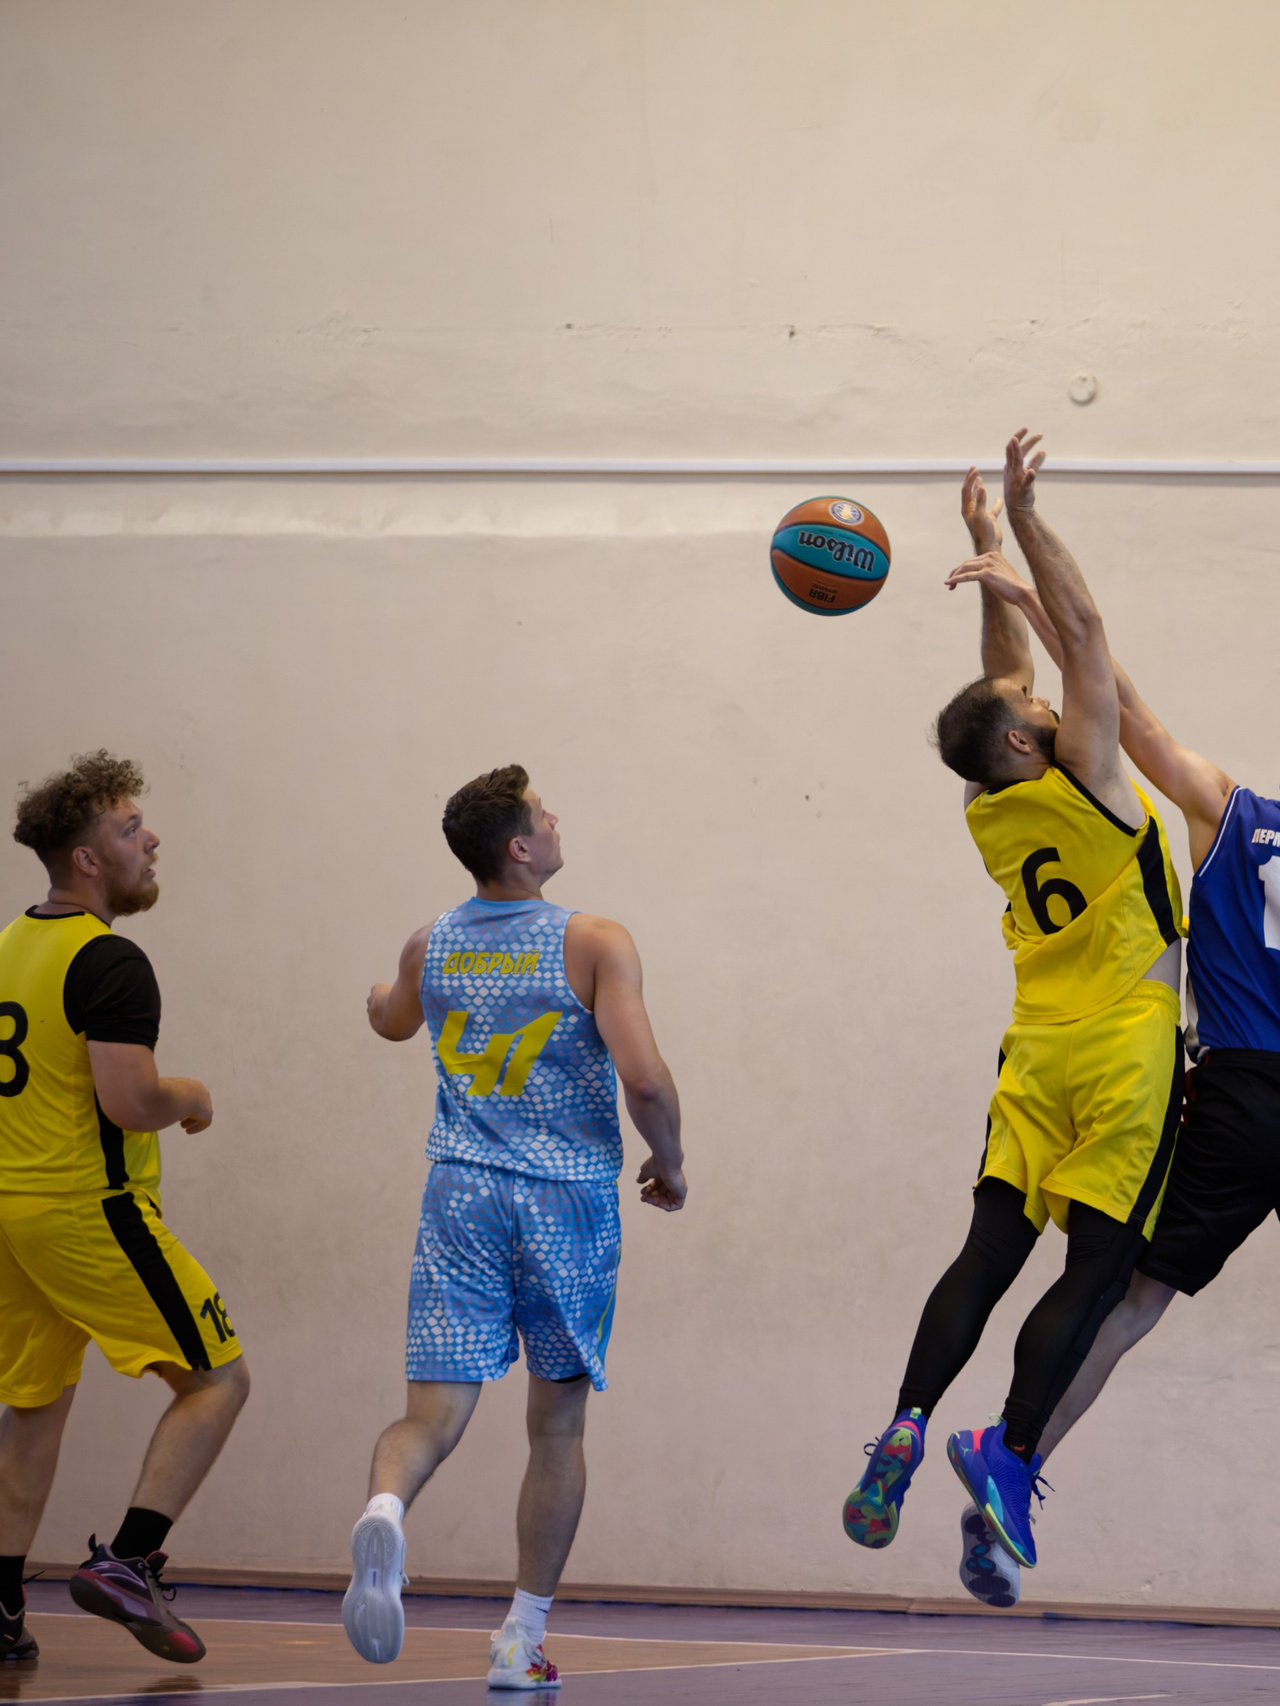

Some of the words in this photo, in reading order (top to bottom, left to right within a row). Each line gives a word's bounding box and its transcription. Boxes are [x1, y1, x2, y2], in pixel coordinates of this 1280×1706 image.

[798, 529, 875, 572] Wilson
[809, 588, 836, 603] FIBA
[1021, 847, 1088, 935] 6
[442, 949, 540, 975] ДОБРЫЙ
[436, 1010, 563, 1096] 41
[199, 1291, 236, 1344] 18
